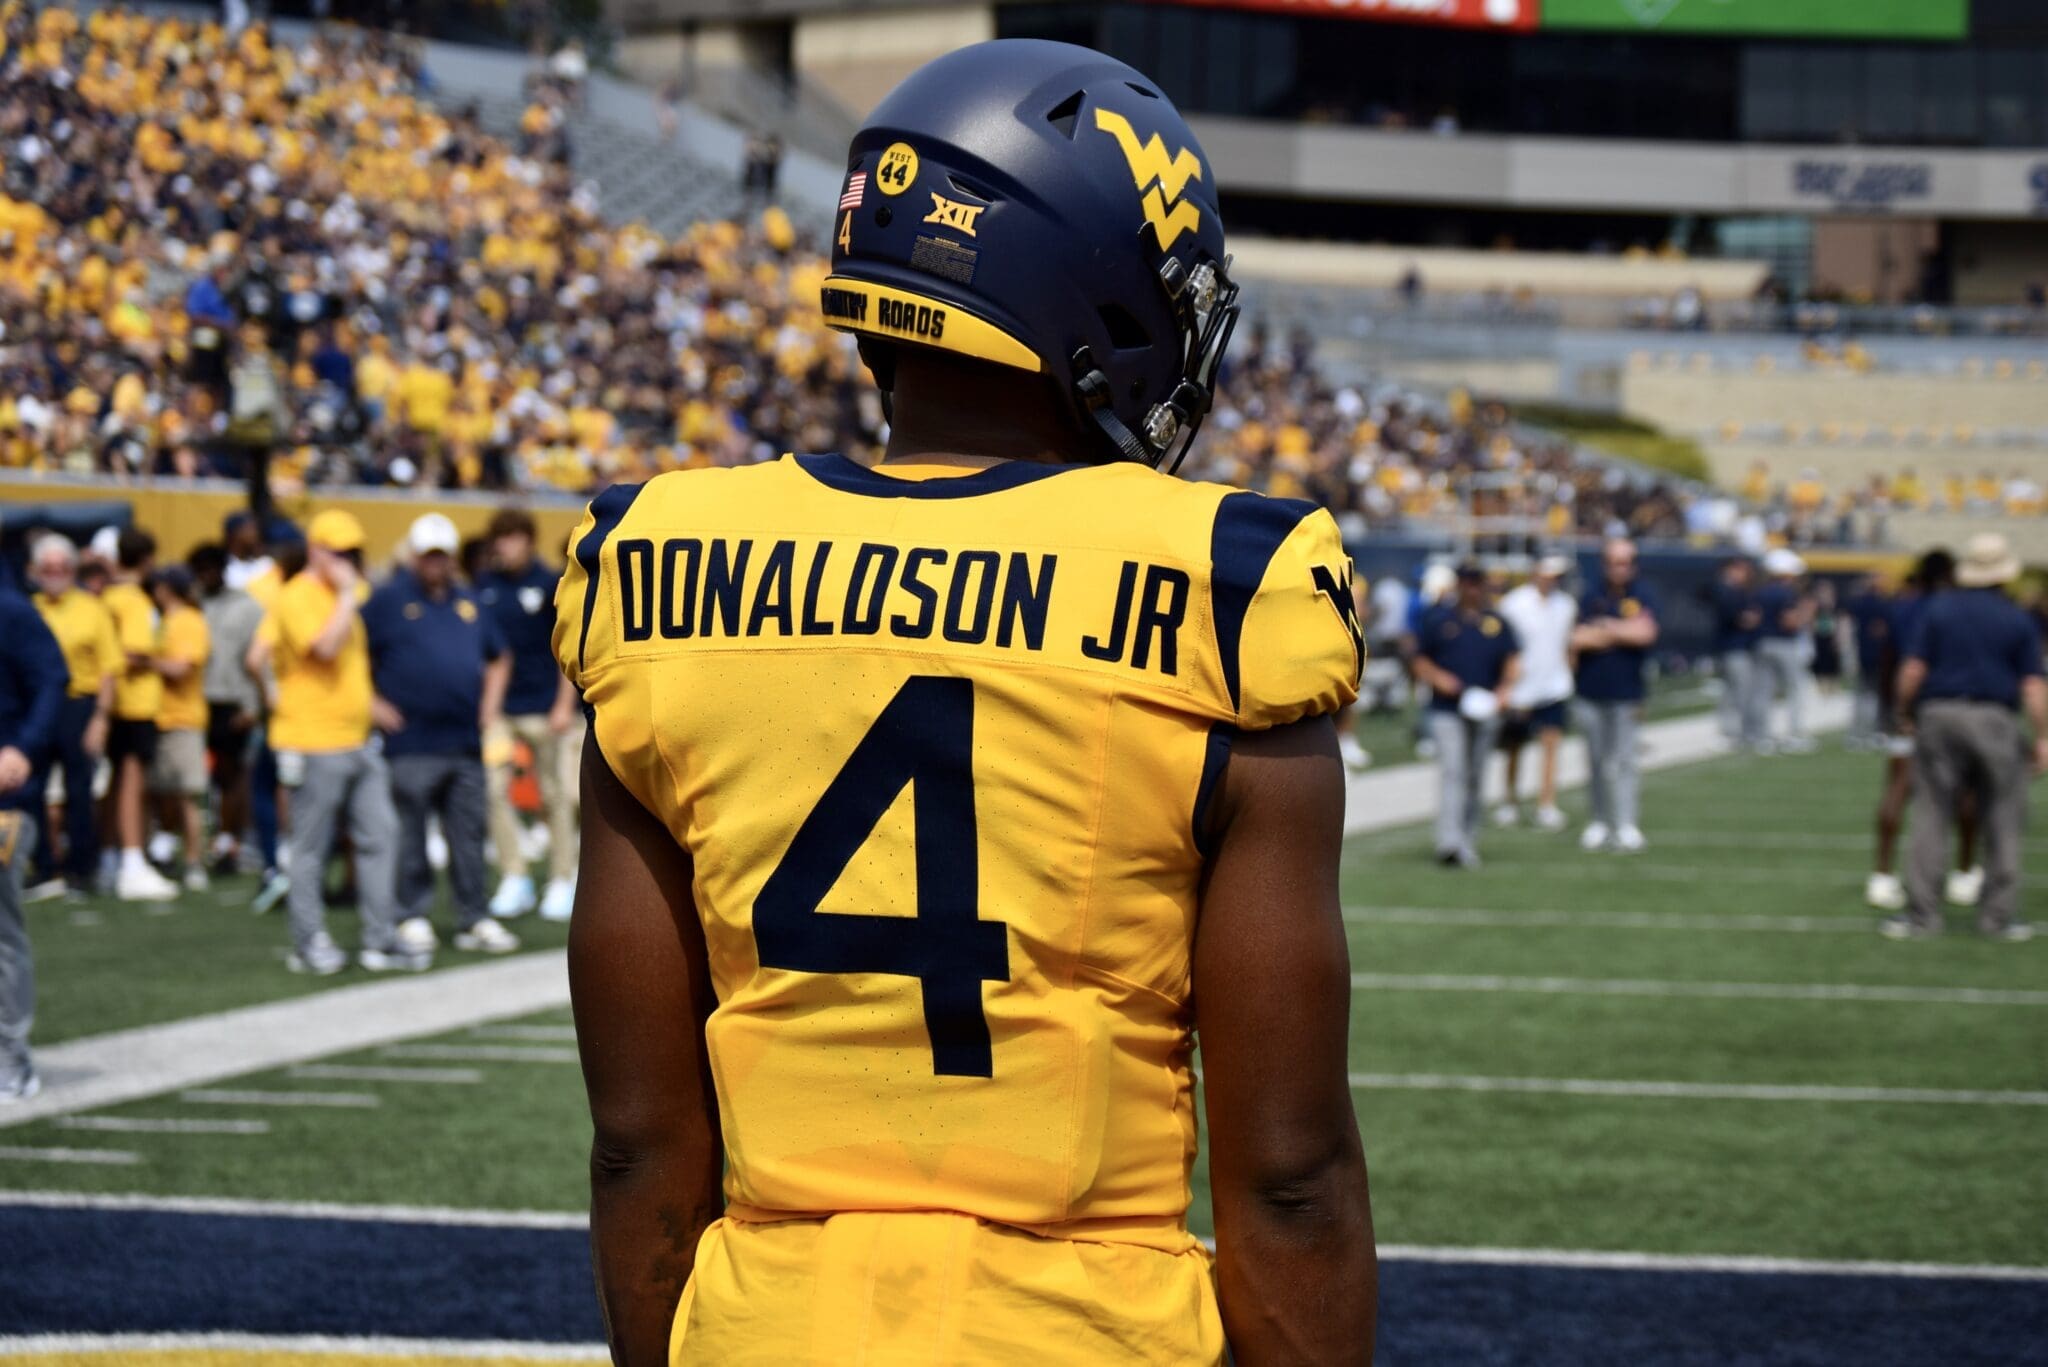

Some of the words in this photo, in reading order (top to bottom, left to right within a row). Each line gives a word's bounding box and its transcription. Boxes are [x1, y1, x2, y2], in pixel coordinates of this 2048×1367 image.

[881, 162, 908, 186] 44
[889, 151, 912, 163] WEST
[838, 210, 852, 256] 4
[923, 191, 985, 238] XII
[878, 297, 946, 338] ROADS
[616, 538, 1057, 651] DONALDSON
[1082, 561, 1190, 676] JR
[752, 675, 1010, 1078] 4
